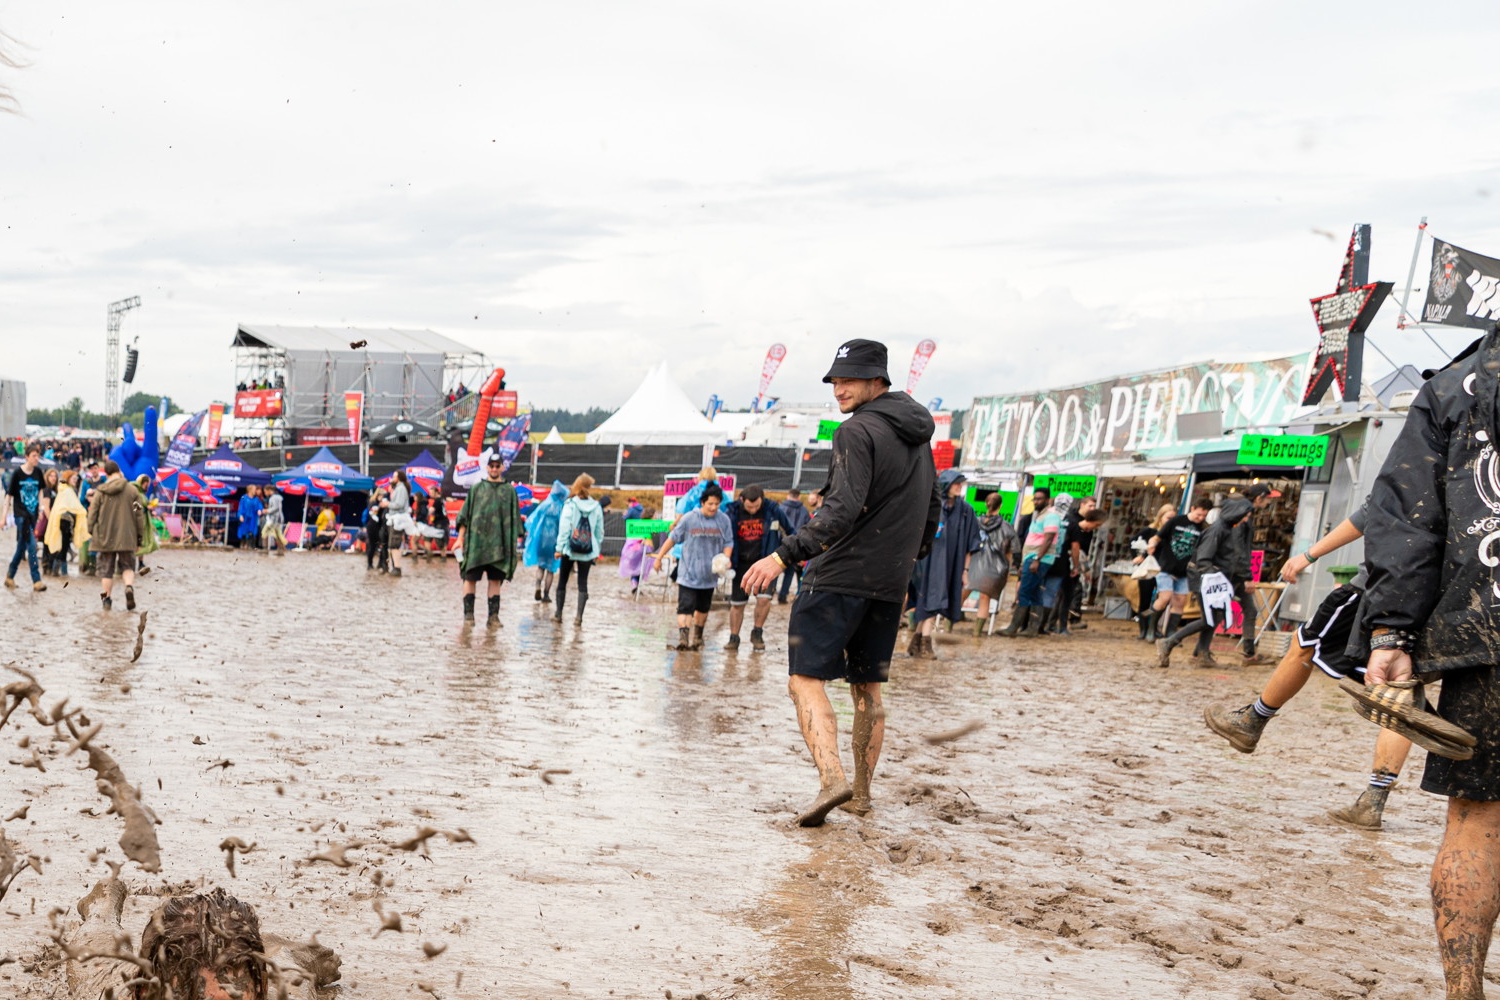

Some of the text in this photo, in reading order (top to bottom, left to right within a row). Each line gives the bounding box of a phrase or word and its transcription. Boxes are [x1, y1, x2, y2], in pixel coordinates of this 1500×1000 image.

[967, 394, 1084, 461] TATTOO
[1088, 405, 1106, 457] &
[1258, 438, 1324, 464] Piercings
[1047, 477, 1093, 497] Piercings
